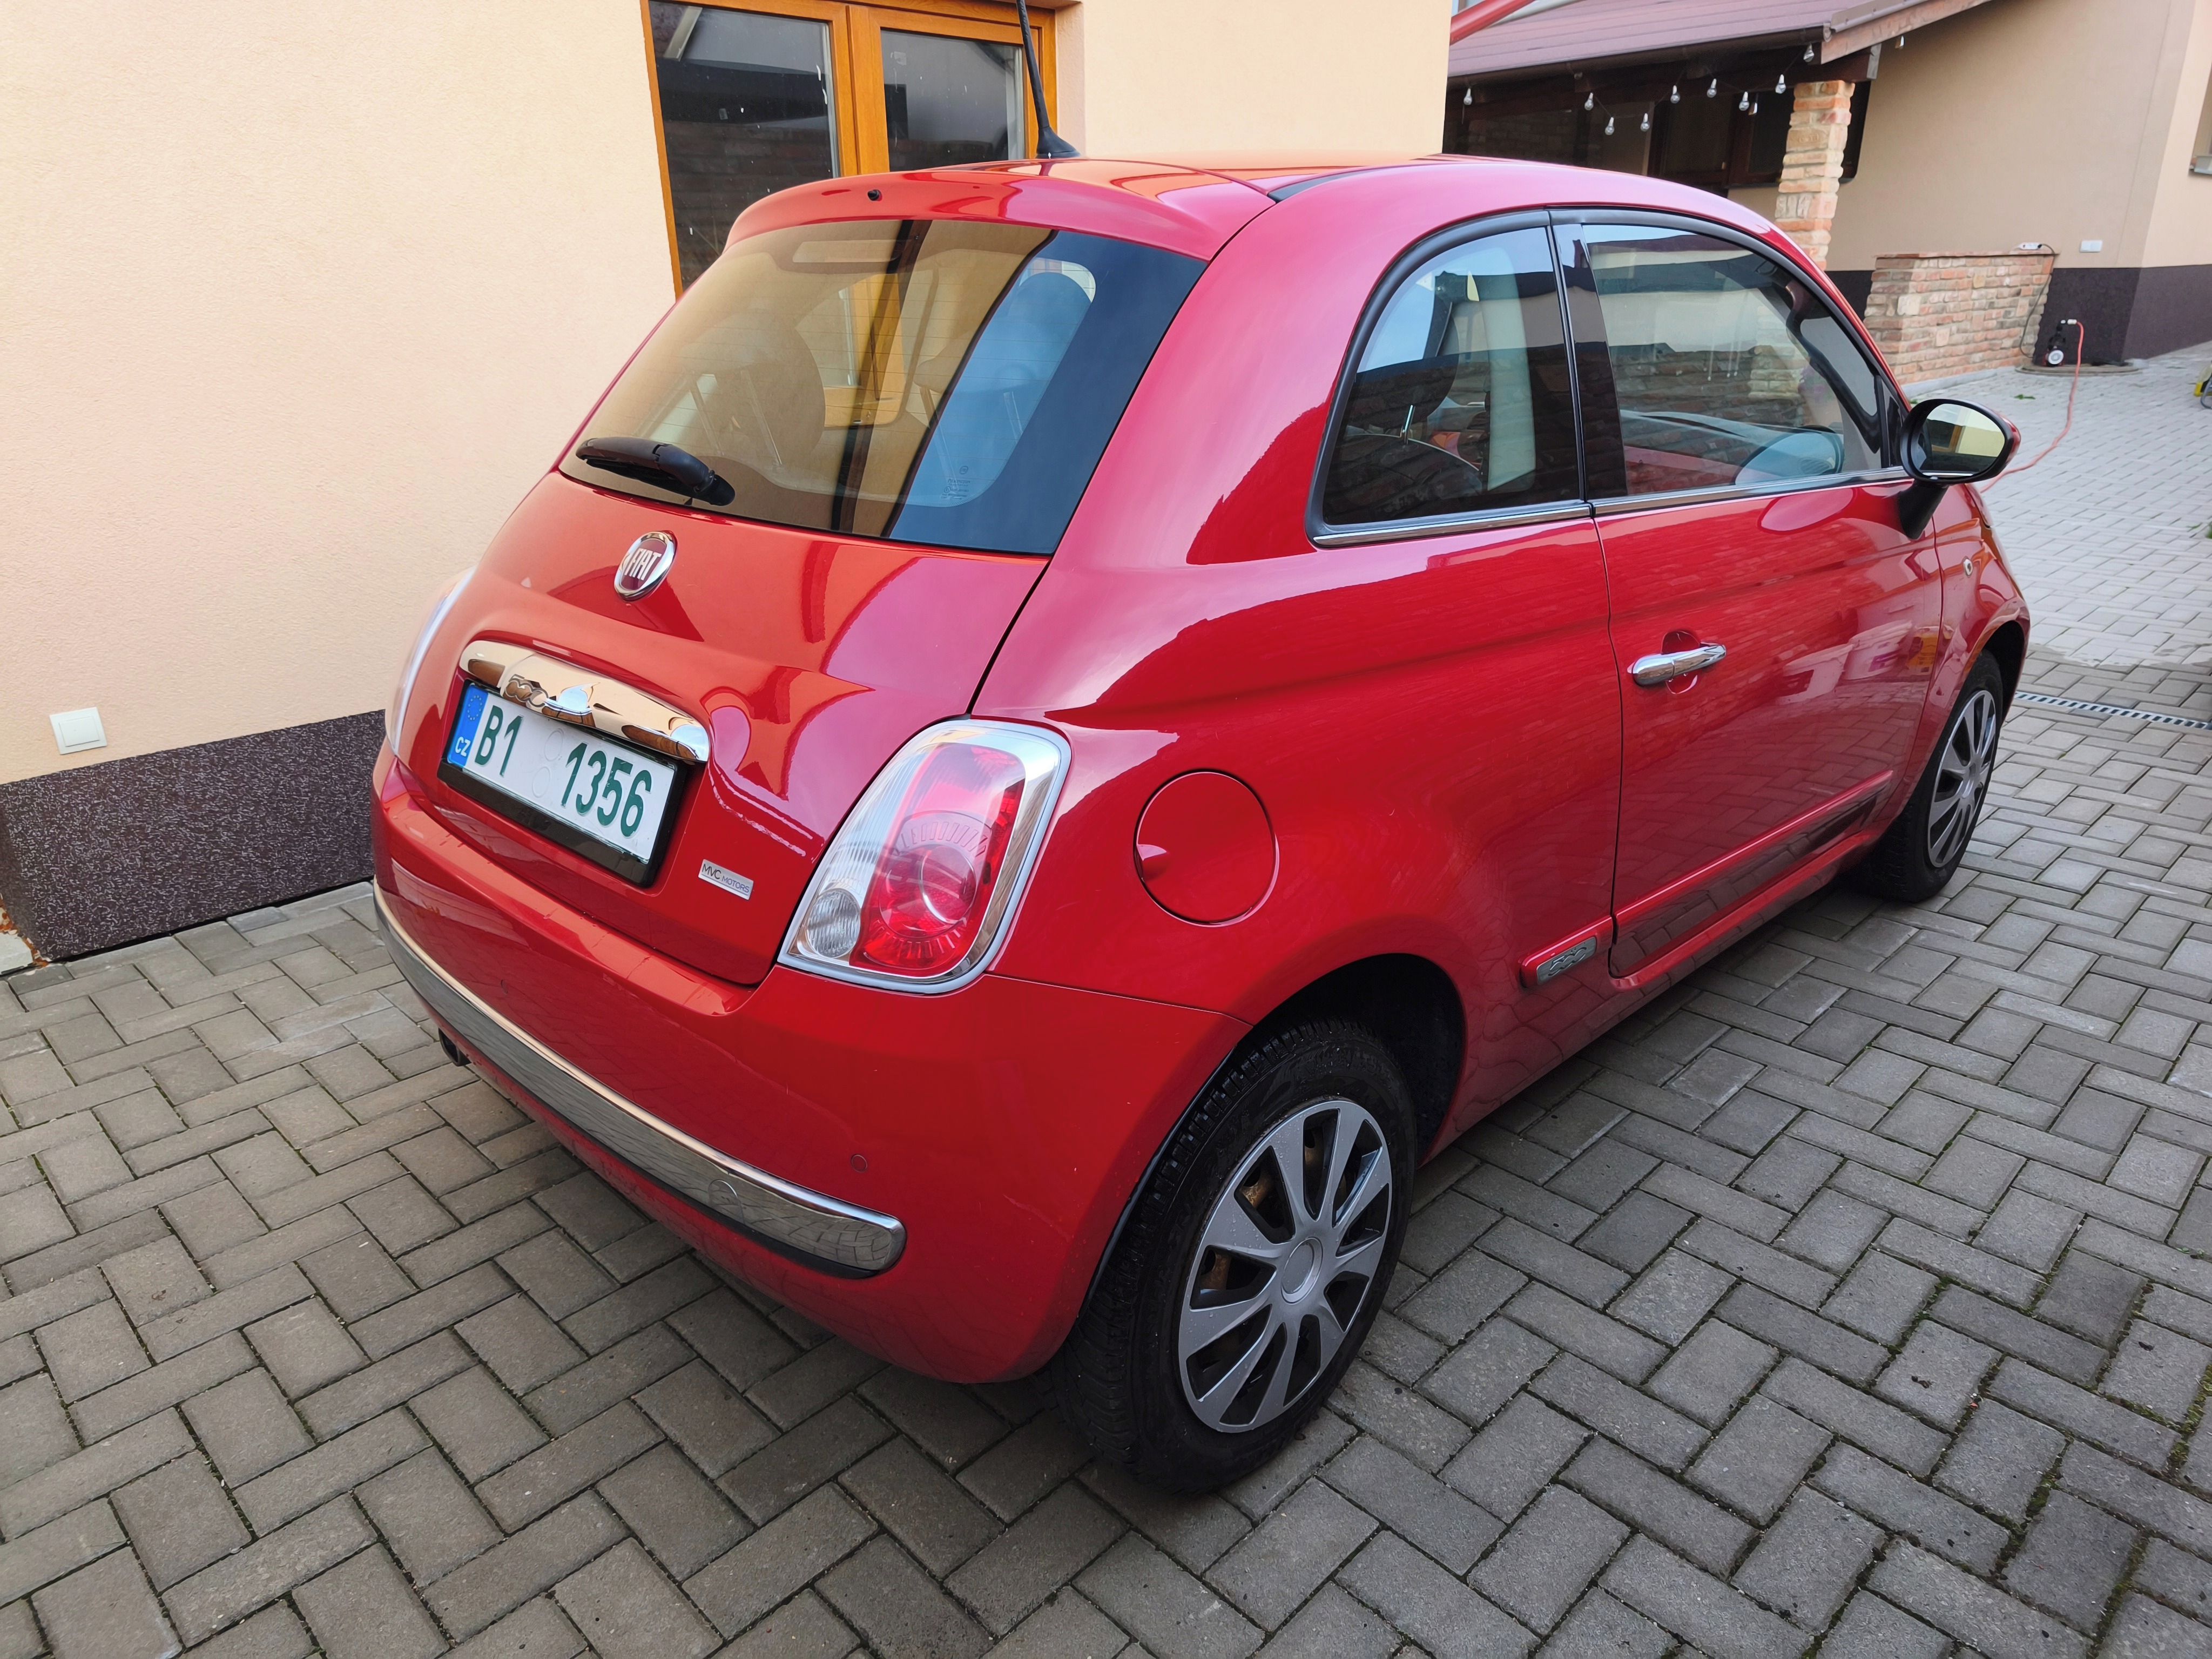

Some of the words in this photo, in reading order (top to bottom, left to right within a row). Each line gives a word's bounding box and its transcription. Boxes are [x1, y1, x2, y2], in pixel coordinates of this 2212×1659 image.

[624, 548, 662, 581] FIAT
[455, 736, 471, 757] CZ
[474, 705, 523, 777] B1
[561, 743, 652, 838] 1356
[702, 864, 721, 880] MVC
[721, 875, 750, 893] MOTORS
